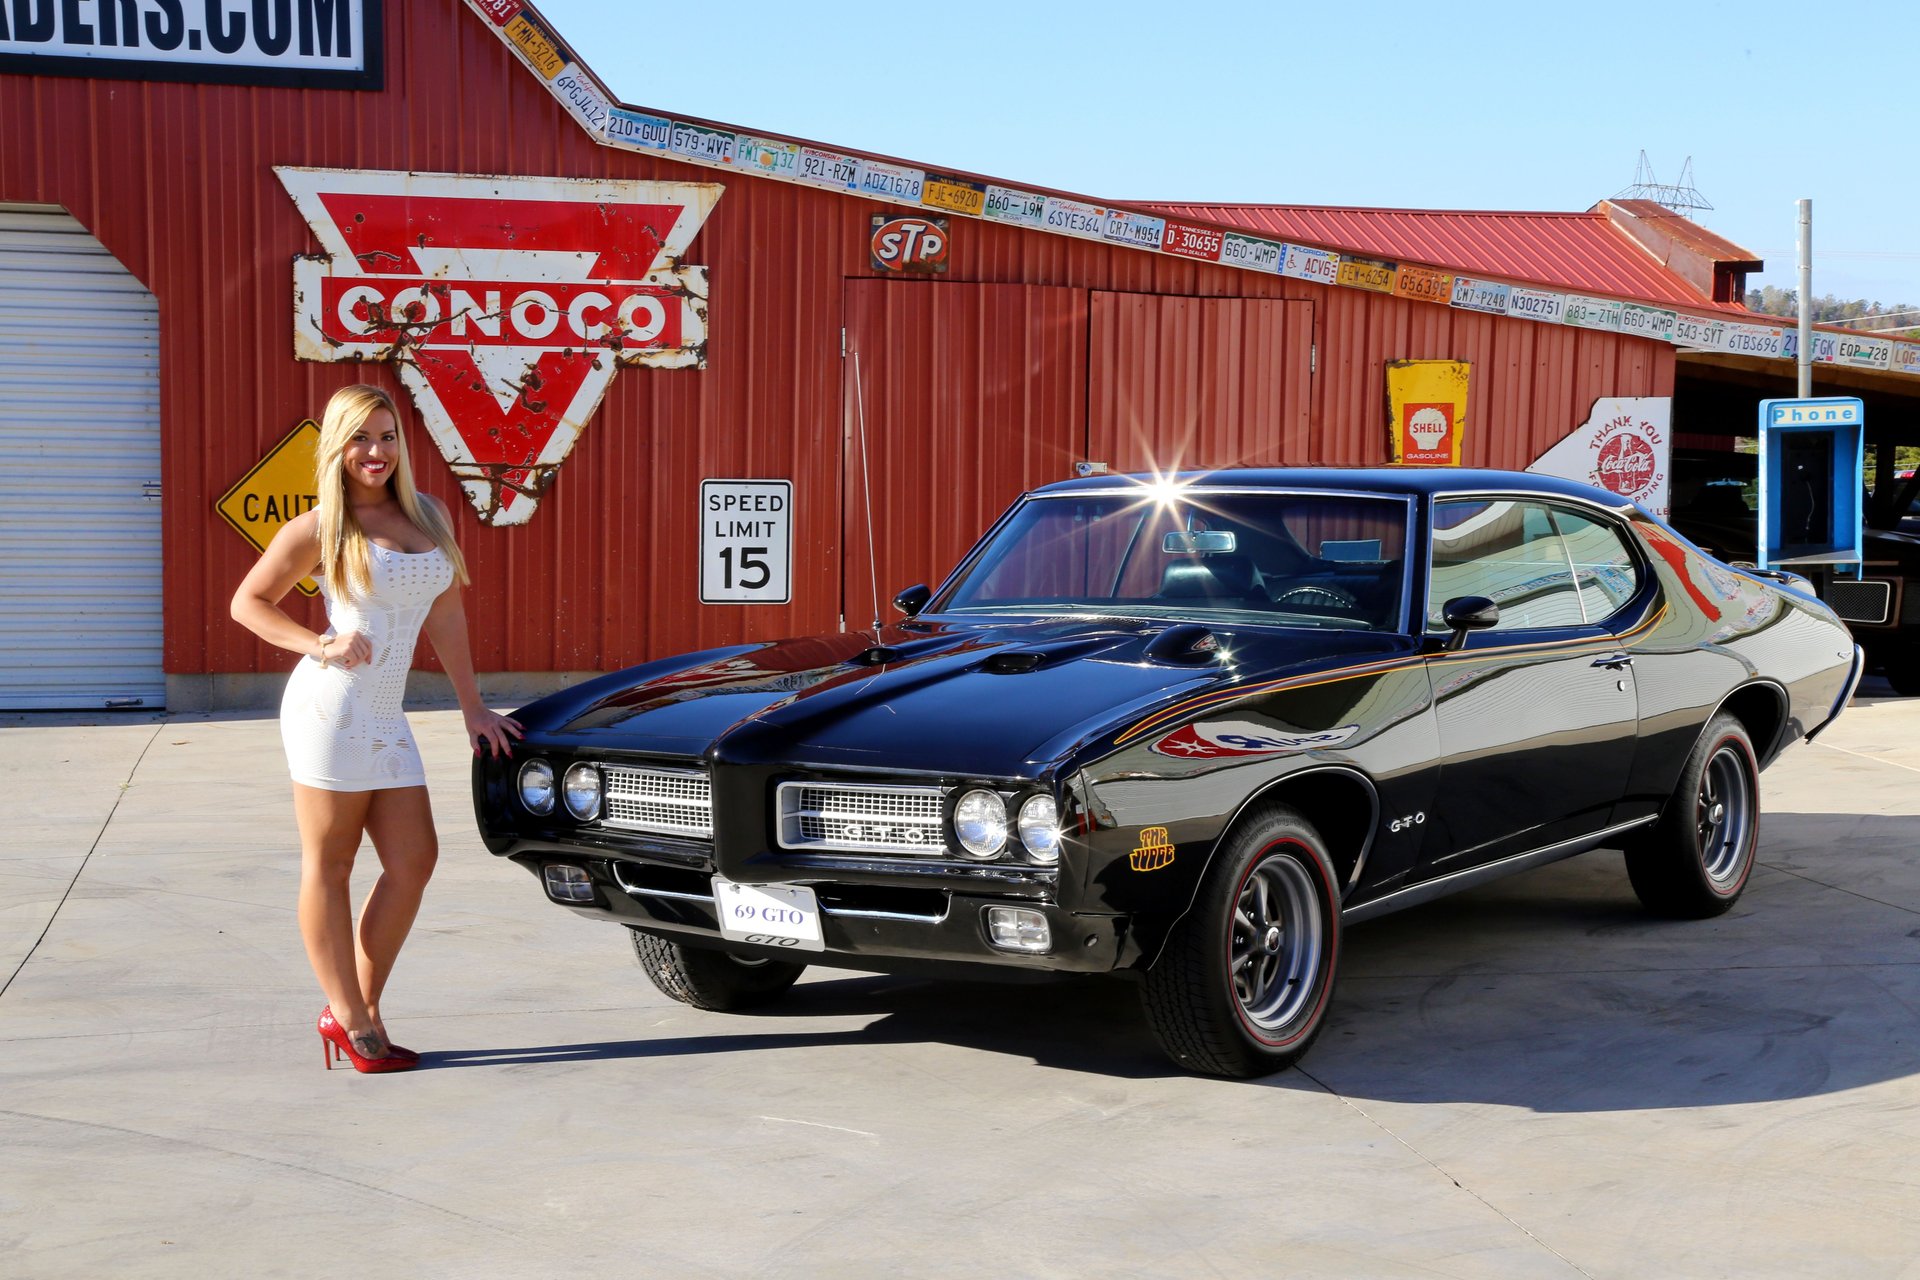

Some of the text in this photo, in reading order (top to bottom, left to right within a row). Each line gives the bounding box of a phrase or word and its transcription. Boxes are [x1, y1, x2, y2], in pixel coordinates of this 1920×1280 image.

[557, 76, 606, 127] 6PGJ412
[608, 116, 634, 137] 210
[641, 124, 667, 143] GUU
[685, 149, 719, 161] COLORADO
[803, 148, 837, 160] WISCONSIN
[804, 157, 857, 183] 921-RZM
[867, 165, 901, 177] WASHINGTON
[863, 171, 920, 196] ADZ1678
[1047, 209, 1100, 233] 6SYE364
[1179, 225, 1212, 235] TENNESSEE
[878, 223, 943, 264] STP
[1294, 245, 1328, 257] FLORIDA
[338, 285, 665, 342] CONOCO
[1511, 295, 1560, 316] N302751
[1728, 334, 1779, 353] 6TBS696
[1773, 408, 1854, 423] Phone
[1412, 423, 1444, 434] SHELL
[1589, 415, 1663, 450] THANK YOU
[243, 493, 318, 523] CAUT
[709, 494, 784, 512] SPEED
[715, 520, 776, 538] LIMIT
[719, 546, 771, 590] 15
[1391, 811, 1425, 833] GTO
[843, 825, 925, 843] GTO
[1140, 826, 1168, 848] THE
[1129, 845, 1176, 872] JUDGE
[734, 904, 804, 925] 69 GTO
[744, 933, 800, 947] GTO
